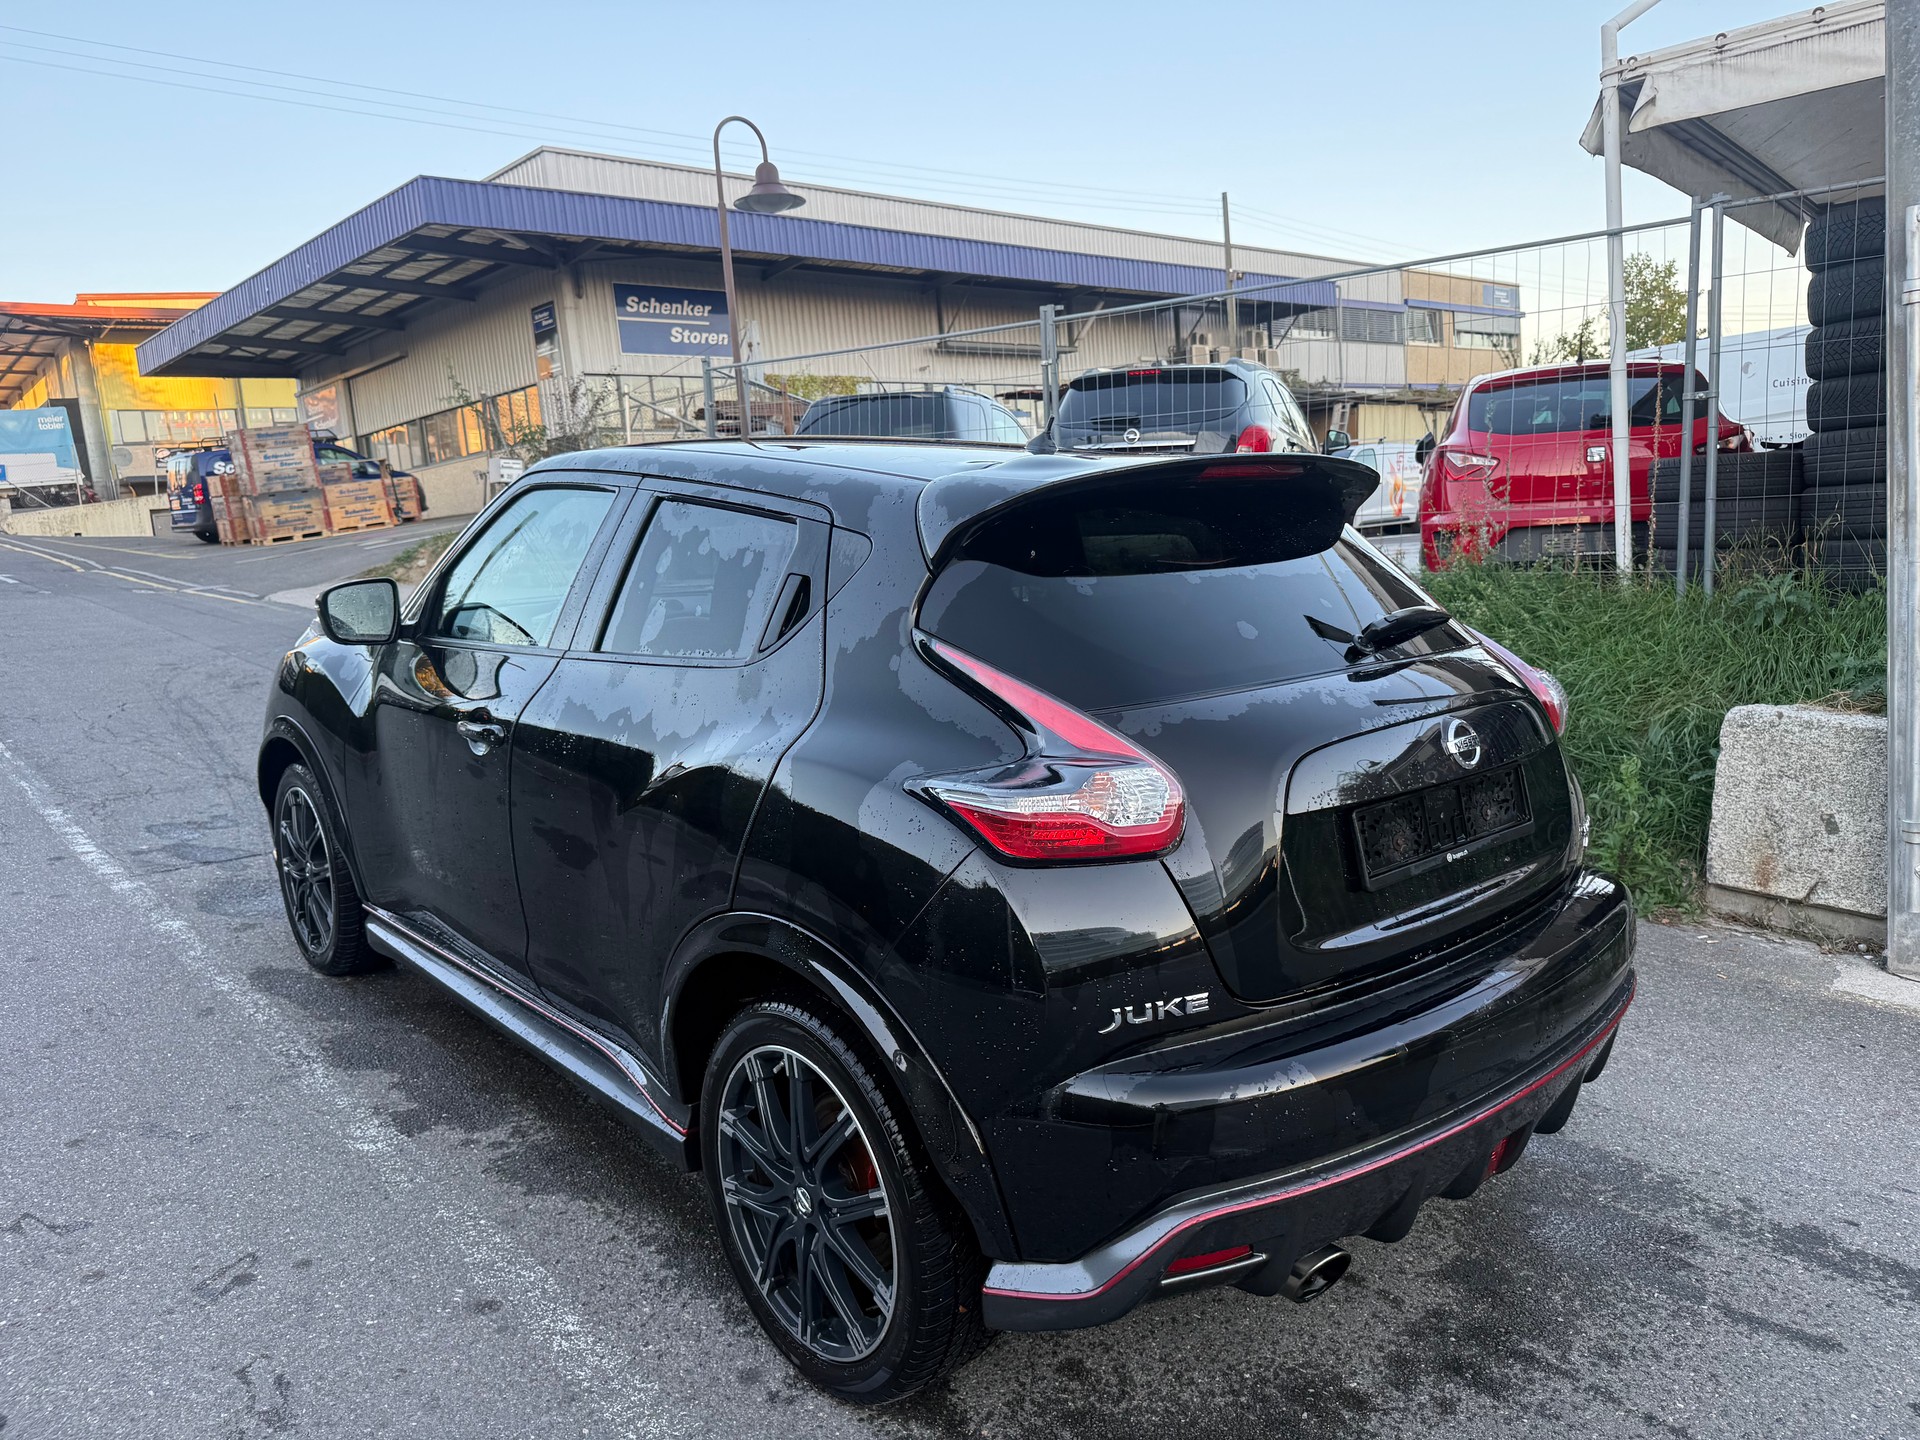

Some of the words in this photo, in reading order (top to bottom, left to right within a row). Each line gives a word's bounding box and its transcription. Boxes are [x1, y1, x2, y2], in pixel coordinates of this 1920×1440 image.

[626, 296, 712, 318] Schenker
[669, 327, 728, 345] Storen
[37, 415, 63, 424] meier
[38, 422, 65, 430] tobler
[1789, 431, 1808, 440] Sion
[1097, 991, 1211, 1034] JUKE
